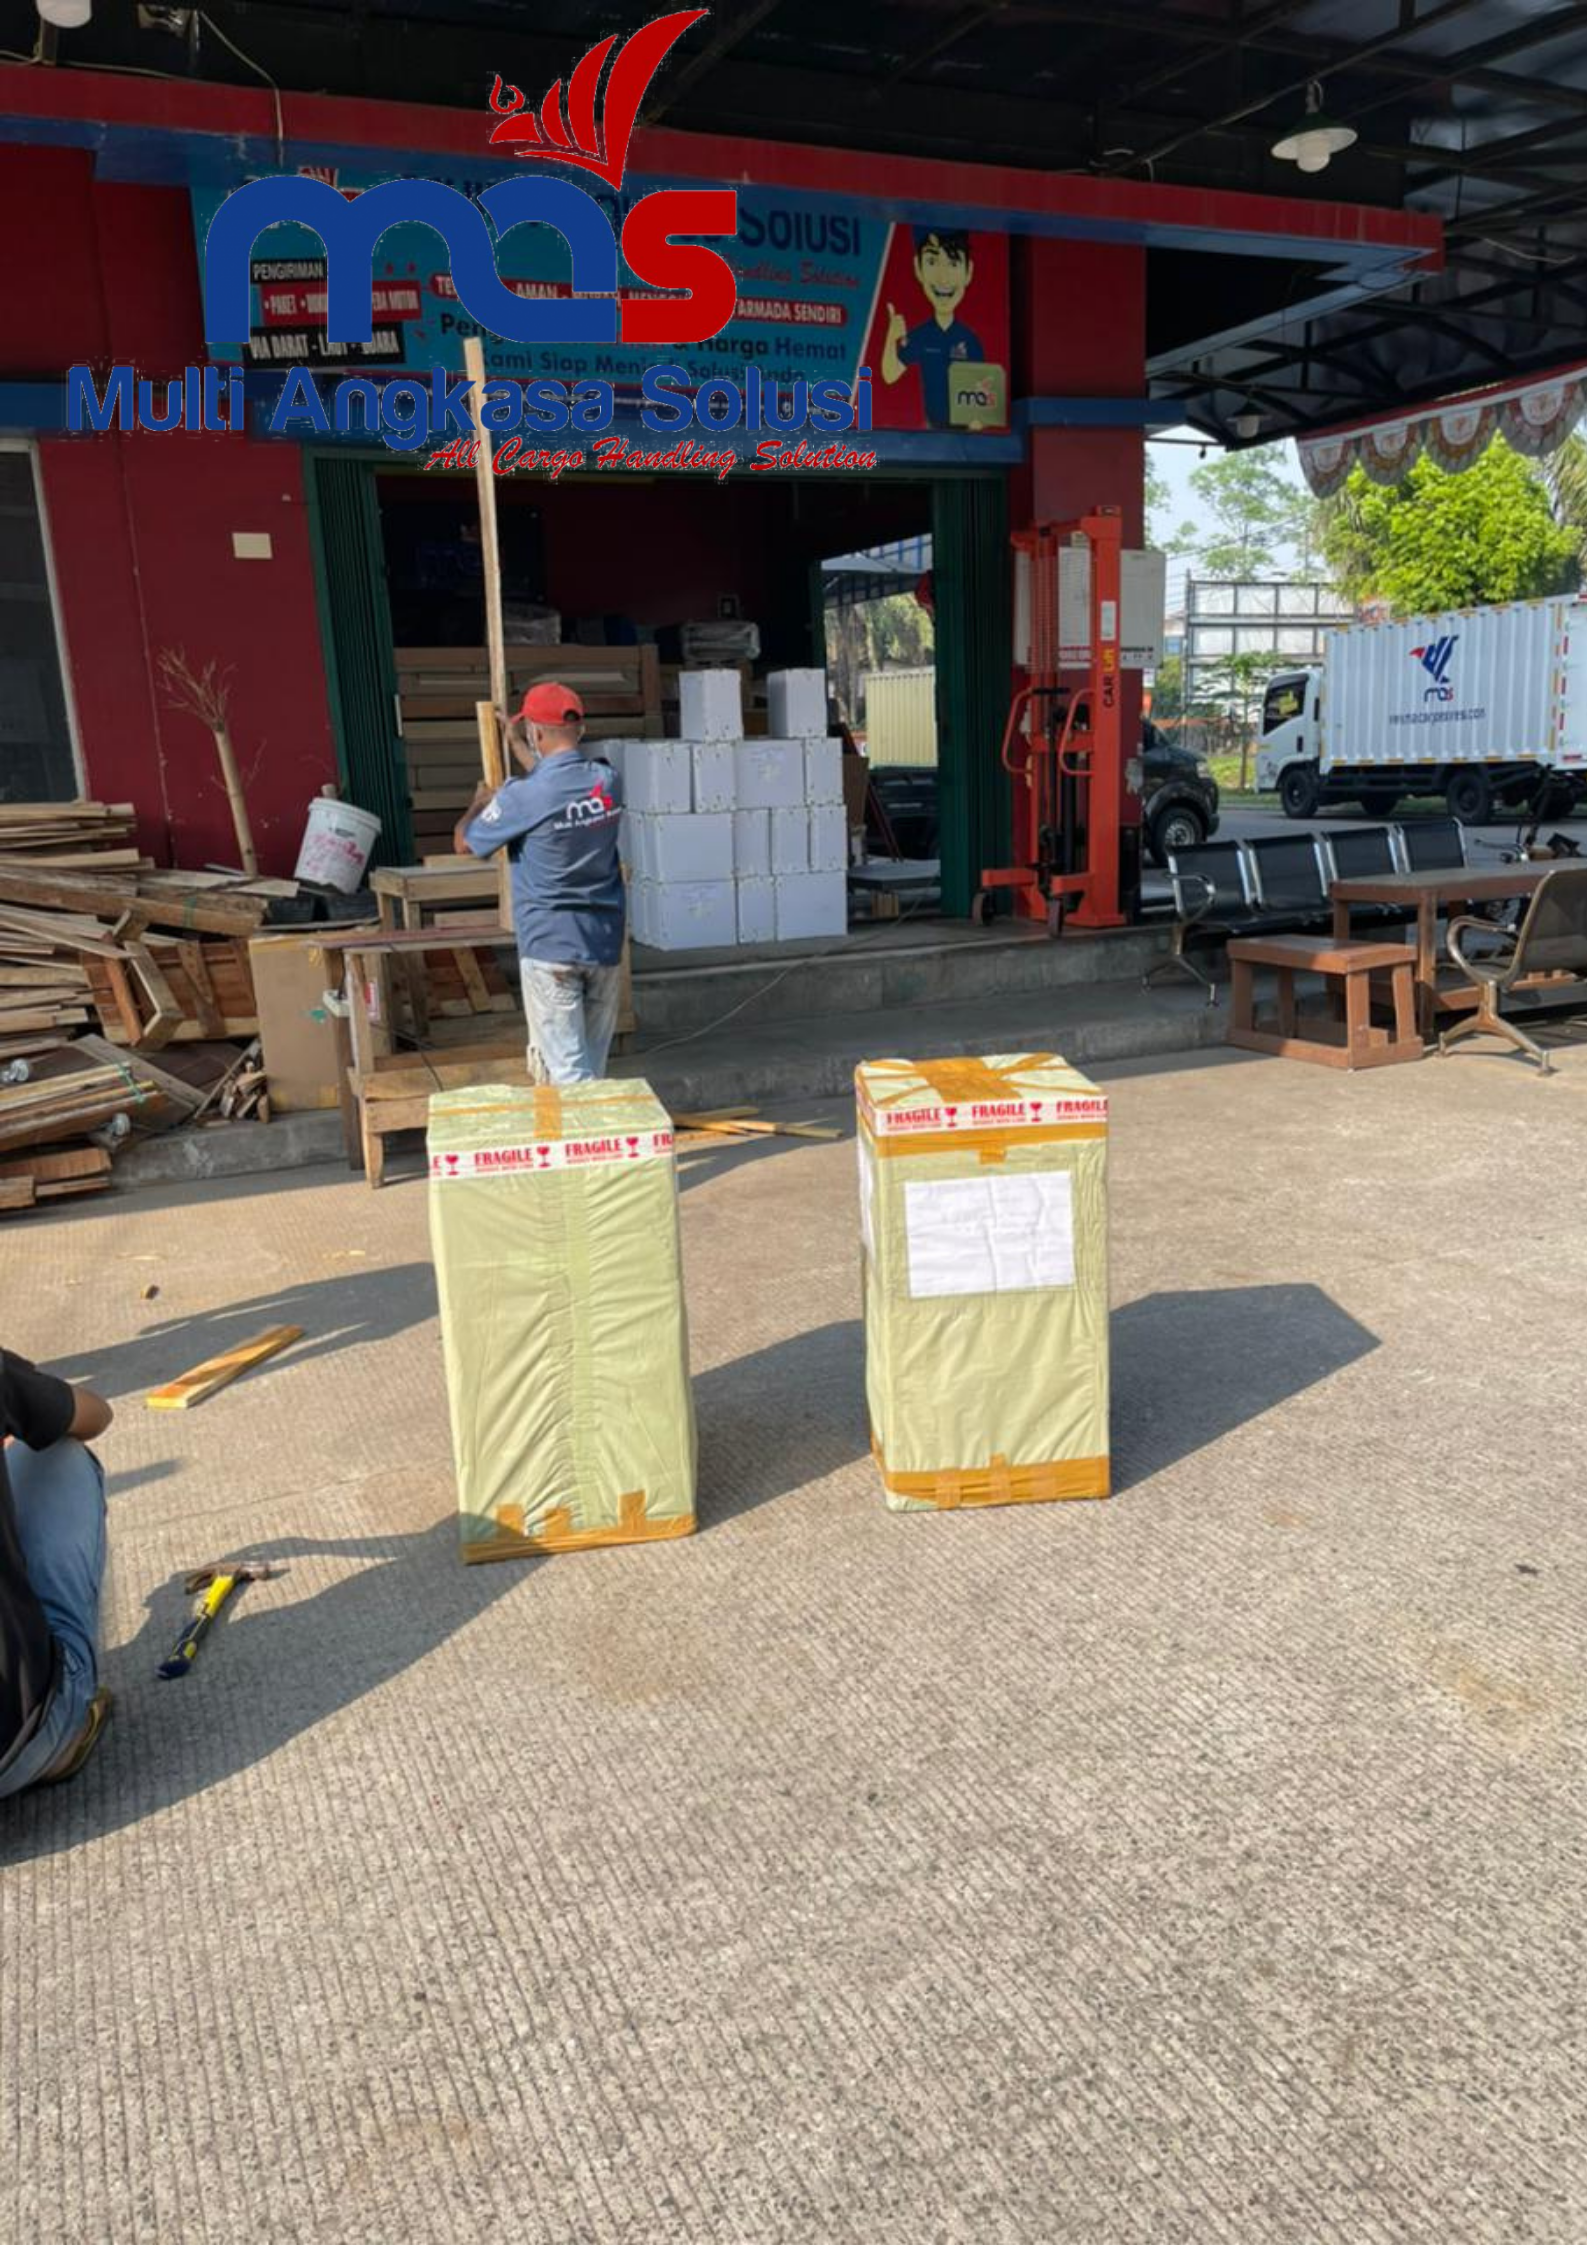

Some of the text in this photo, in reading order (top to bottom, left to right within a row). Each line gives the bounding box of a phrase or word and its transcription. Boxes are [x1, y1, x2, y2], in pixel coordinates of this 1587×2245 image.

[252, 262, 324, 281] PENGIRIMAN
[737, 299, 842, 324] ARMADA SENDIRI
[270, 333, 309, 359] DARAT
[775, 336, 846, 361] Hemat
[540, 350, 587, 375] Siap
[887, 1099, 1108, 1125] FRAGILE FRAGILE FRAGILE
[474, 1137, 621, 1167] FRAGILE FRAGILE
